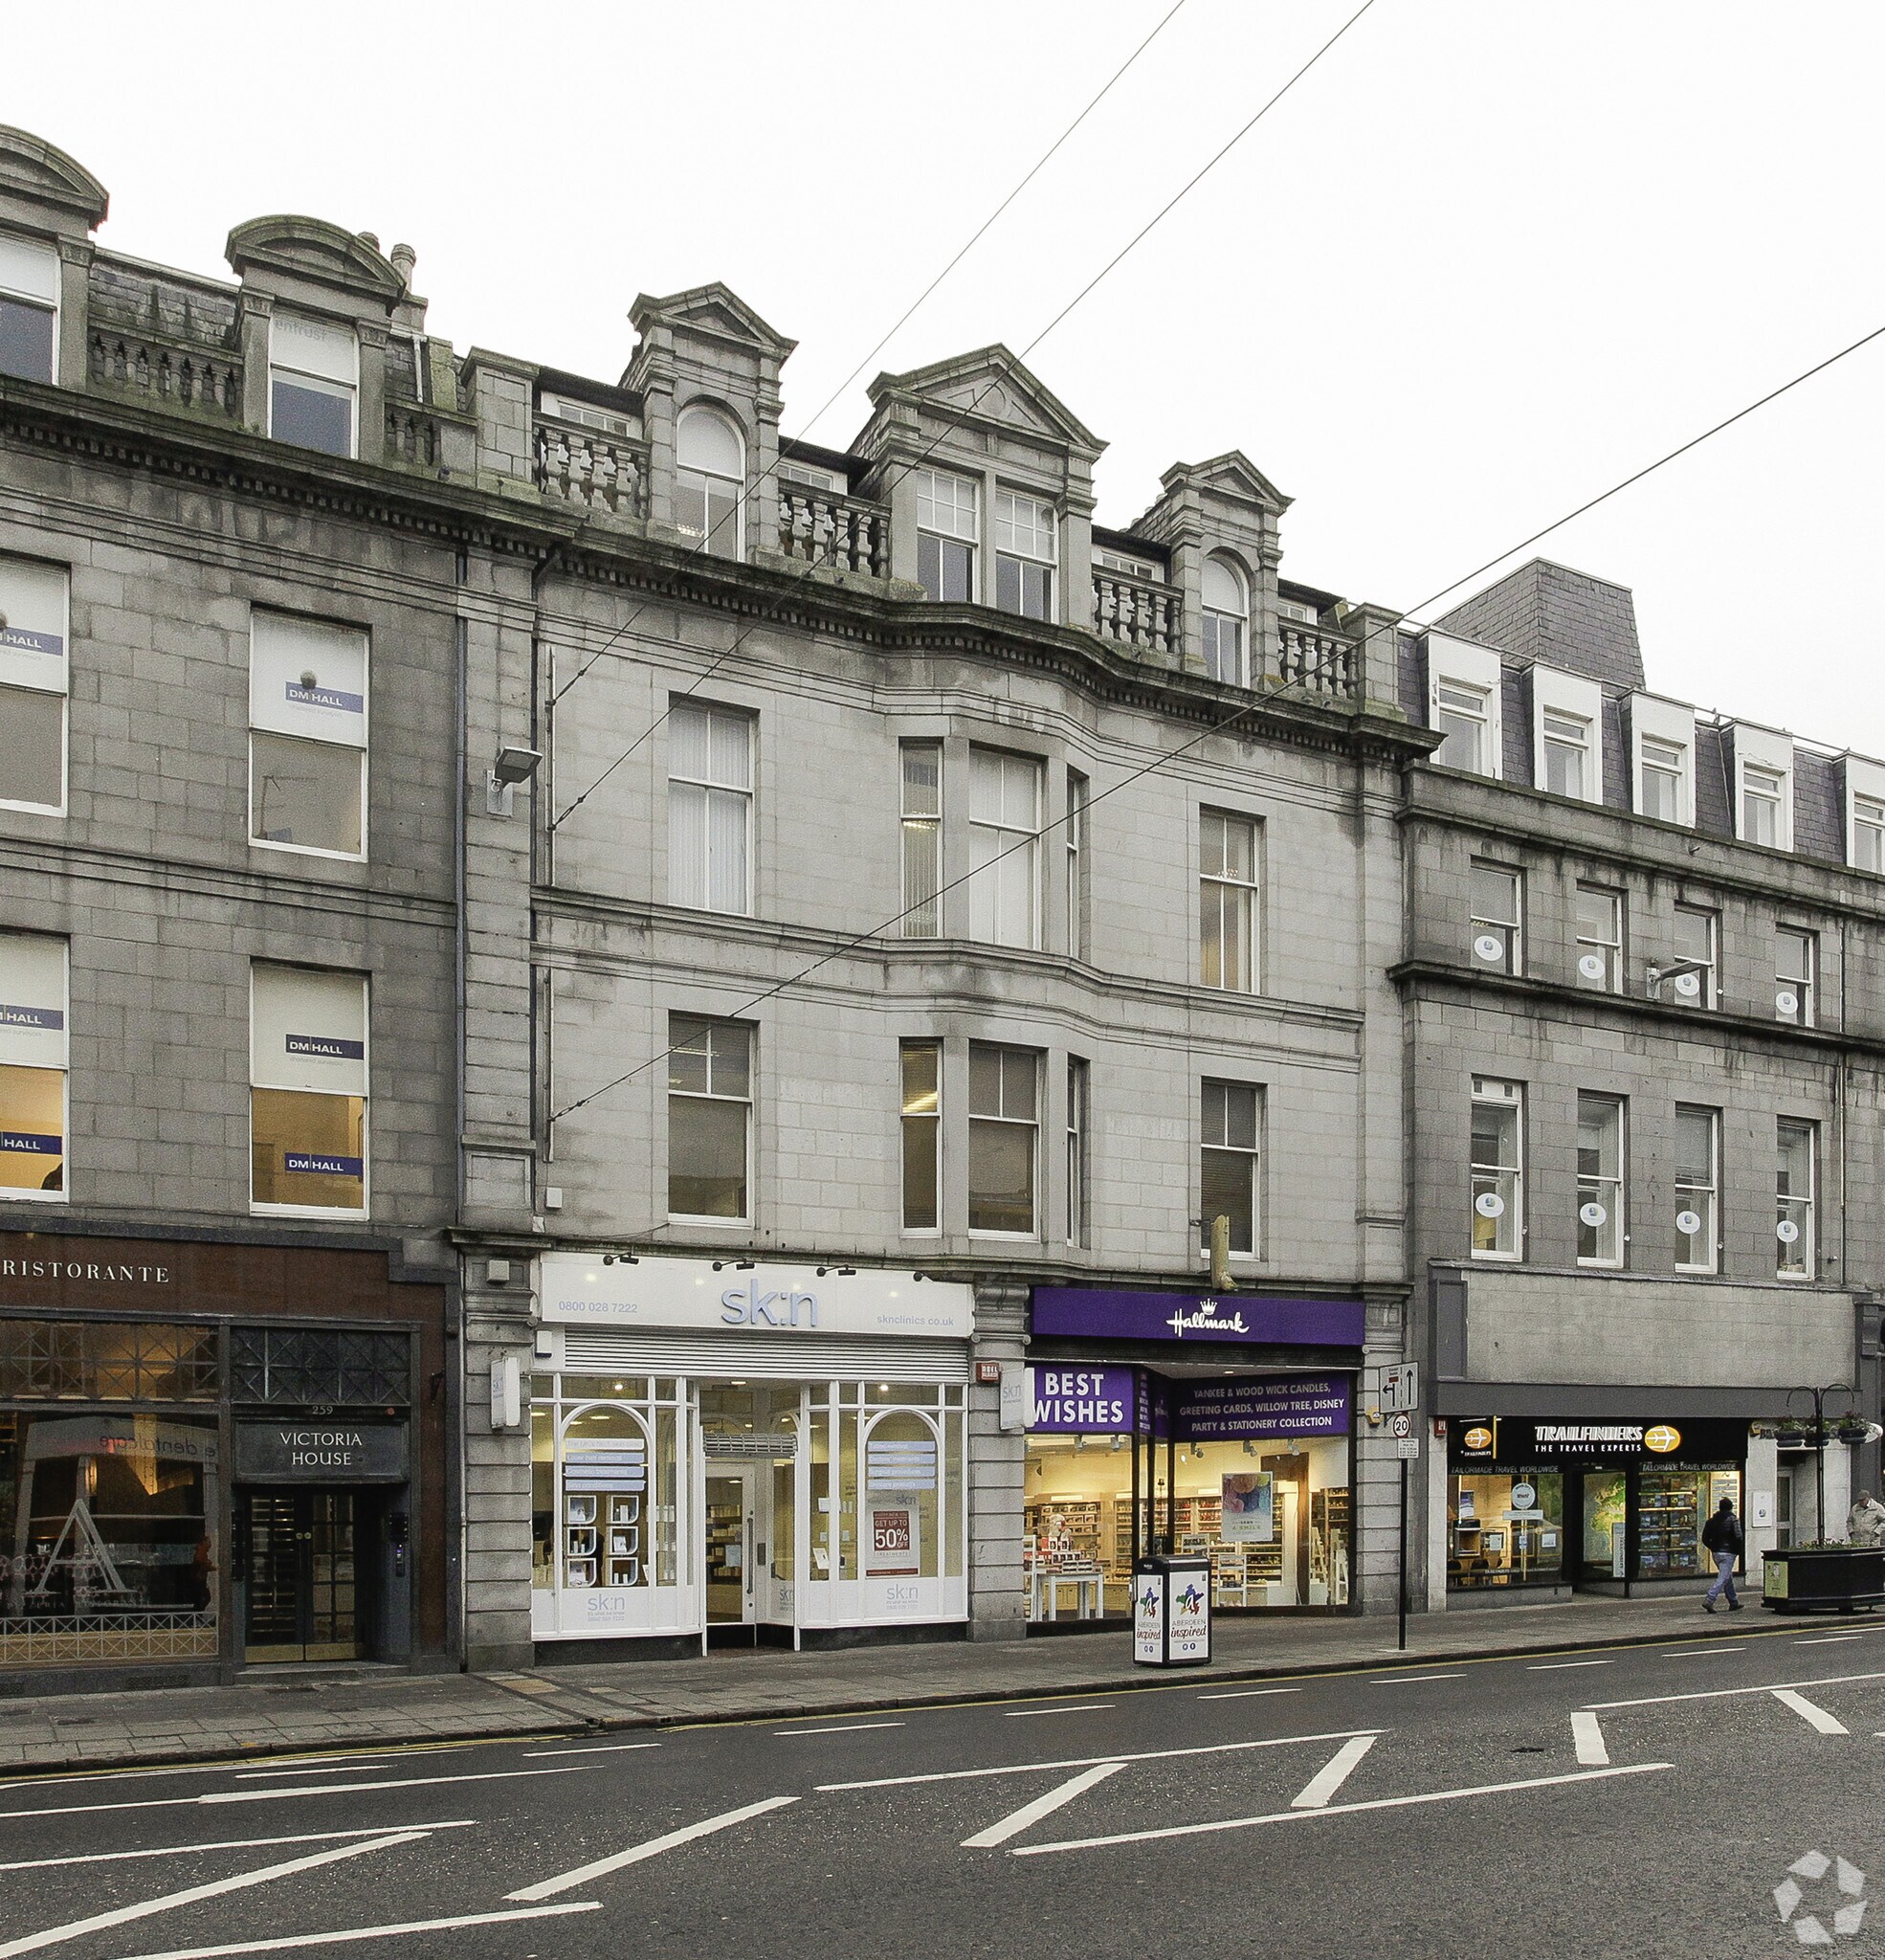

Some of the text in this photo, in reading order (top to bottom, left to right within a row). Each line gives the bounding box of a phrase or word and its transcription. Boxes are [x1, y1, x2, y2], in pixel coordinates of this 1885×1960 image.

[7, 634, 42, 649] HALL
[289, 689, 343, 706] DM HALL
[7, 1013, 42, 1024] HALL
[289, 1041, 343, 1055] DM HALL
[4, 1139, 40, 1149] HALL
[288, 1159, 344, 1171] DM HALL
[2, 1259, 169, 1283] RISTORANTE
[558, 1301, 638, 1313] 0800 028 7222
[721, 1279, 819, 1327] sk:n
[876, 1314, 954, 1326] sknclinics co.uk
[1165, 1307, 1250, 1338] Hallmark
[1045, 1372, 1104, 1396] BEST
[1193, 1383, 1331, 1398] YANKEE & WOOD WICK CANDLES,
[312, 1405, 334, 1415] 259
[1034, 1400, 1123, 1423] WISHES
[1180, 1405, 1221, 1415] GREETING
[1223, 1403, 1253, 1414] CARDS,
[1255, 1401, 1288, 1412] WILLOW
[1290, 1400, 1313, 1412] TREE,
[1314, 1398, 1344, 1410] DISNEY
[1191, 1416, 1332, 1432] PARTY & STATIONERY COLLECTION
[1395, 1420, 1408, 1432] 20
[279, 1432, 363, 1446] VICTORIA
[1534, 1426, 1643, 1441] TRAILFINDERS
[1601, 1443, 1642, 1452] EXPERTS
[292, 1452, 352, 1465] HOUSE
[1452, 1465, 1559, 1474] TAILORMADE TRAVEL WORLDWIDE
[1642, 1462, 1737, 1472] TAILORMADE TRAVEL WORLDWIDE
[875, 1528, 909, 1548] 50%
[588, 1592, 625, 1611] sk:n
[1136, 1628, 1162, 1641] inspired
[1170, 1625, 1207, 1638] inspired
